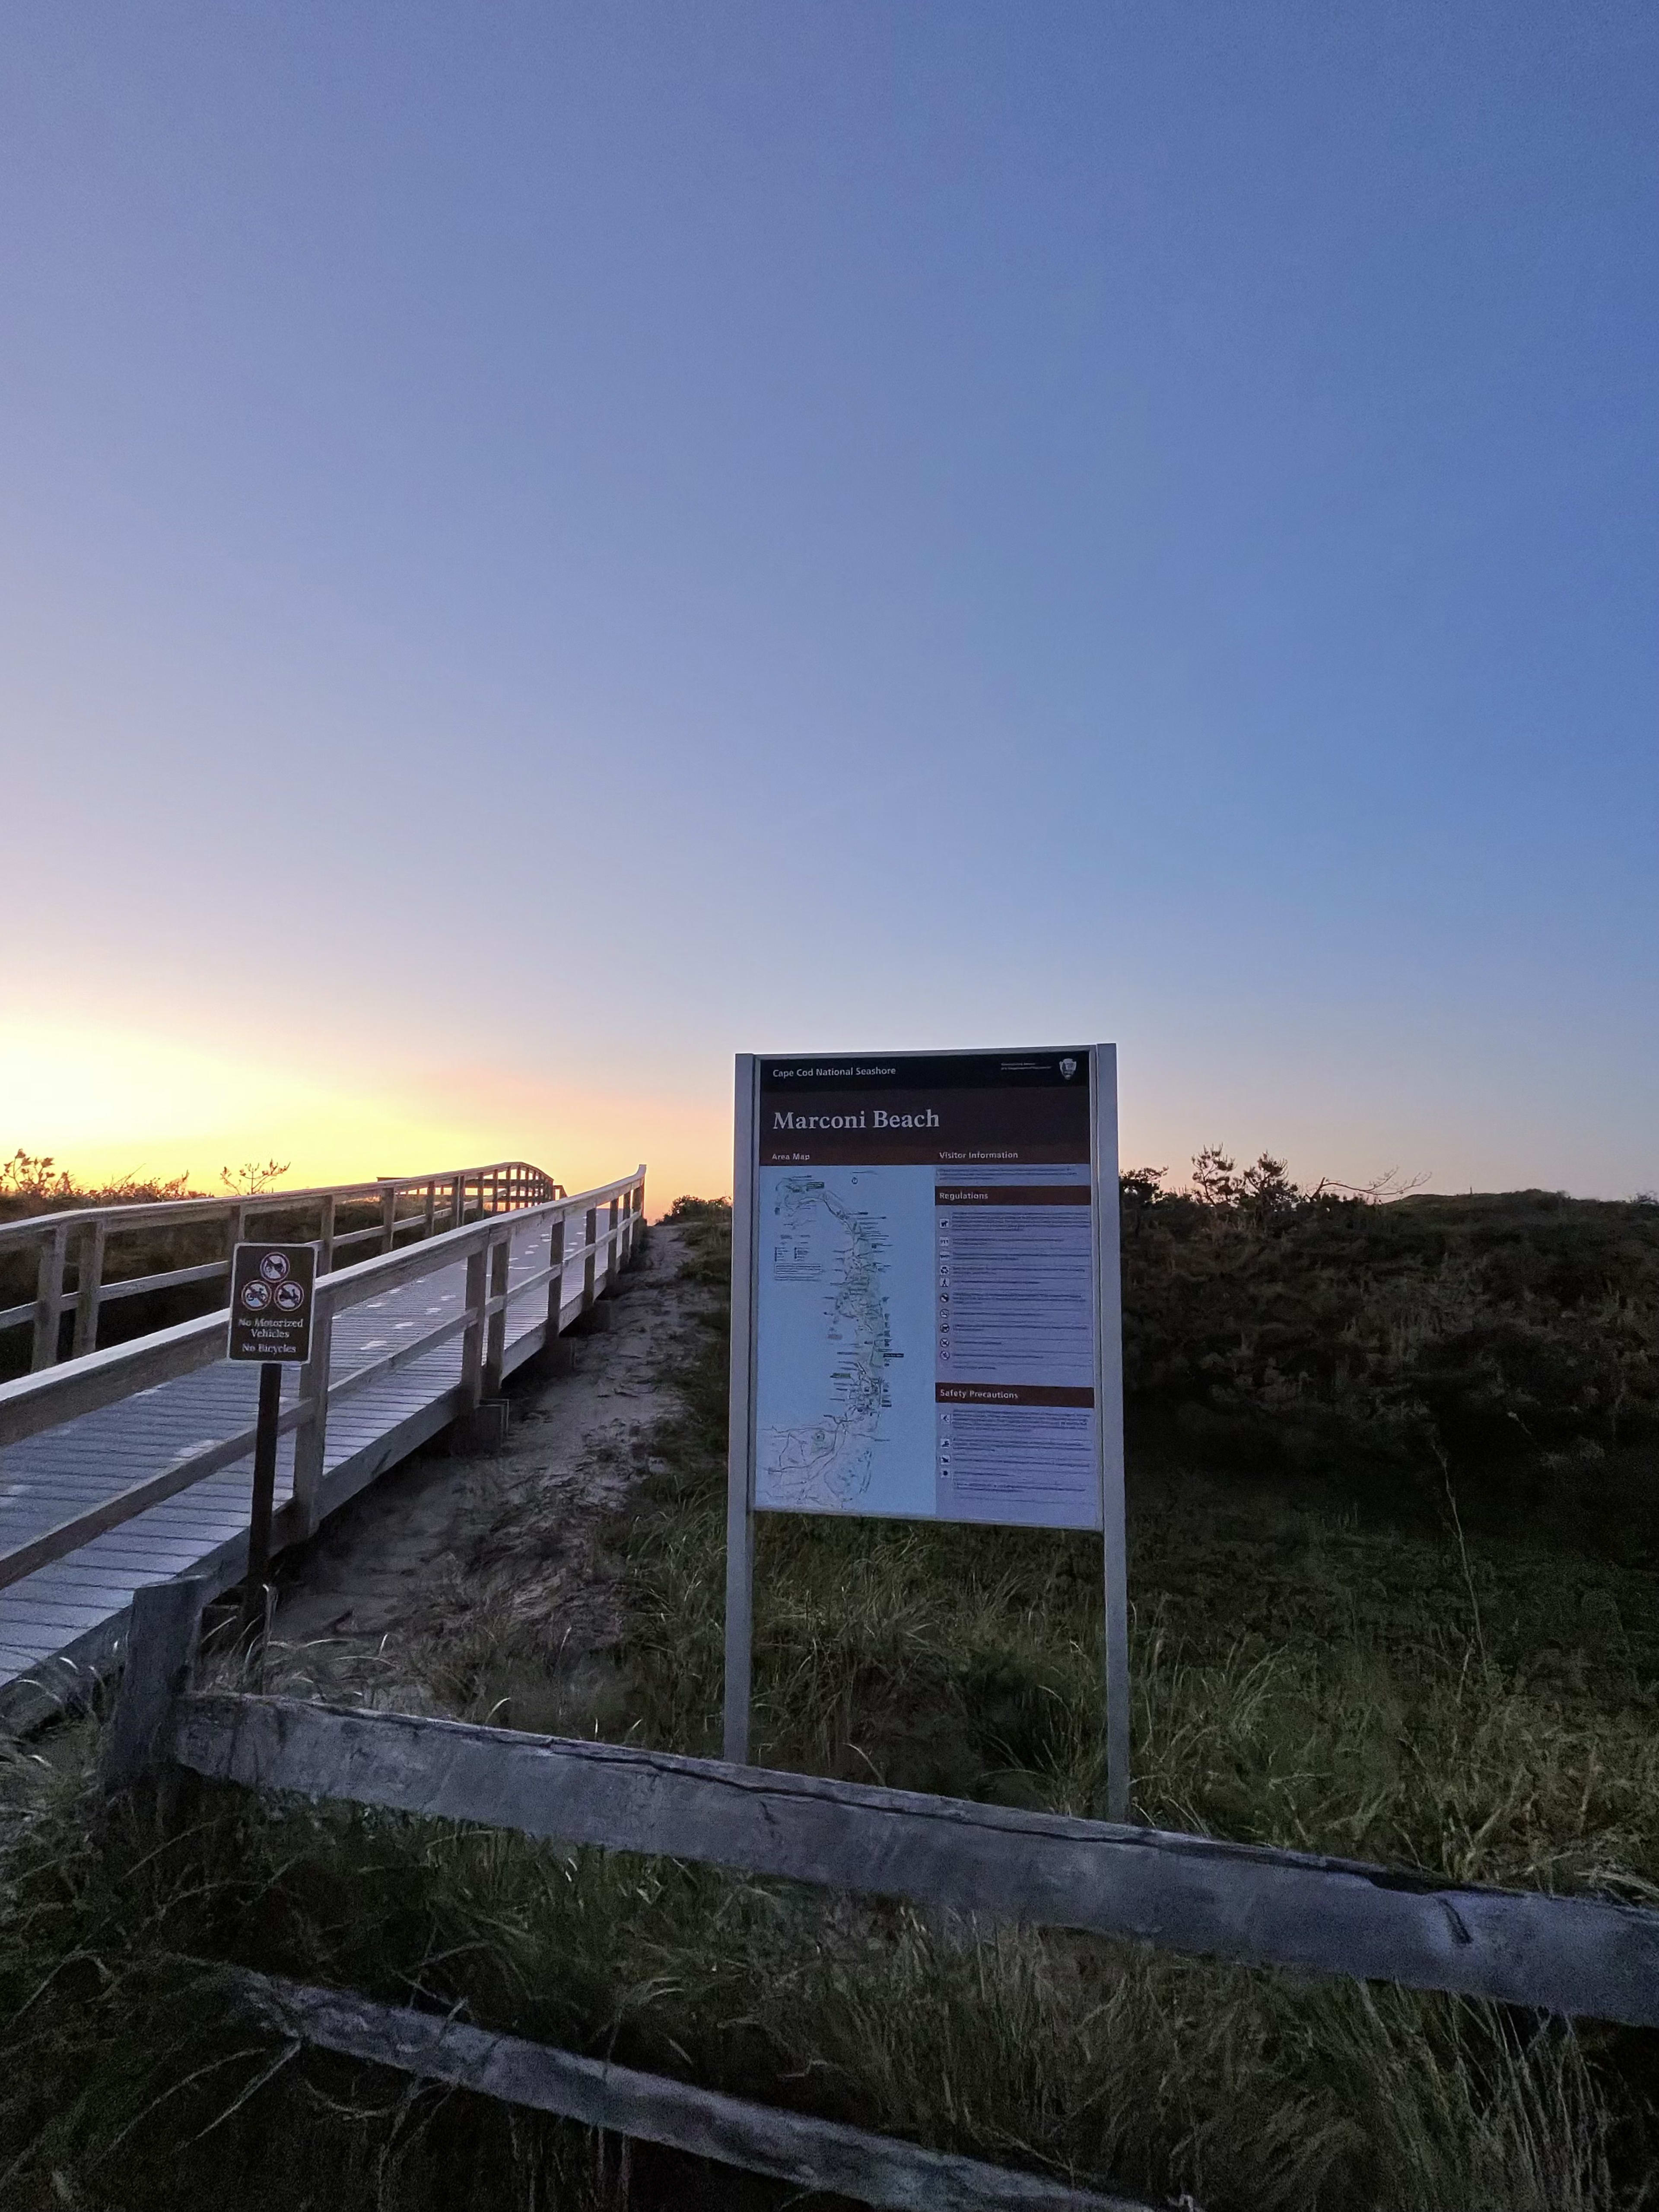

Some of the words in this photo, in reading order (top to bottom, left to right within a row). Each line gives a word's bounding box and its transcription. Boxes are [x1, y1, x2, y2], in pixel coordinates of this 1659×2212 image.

[772, 1069, 794, 1079] Cape
[796, 1068, 813, 1077] Cod
[816, 1067, 853, 1076] National
[856, 1067, 896, 1075] Seashore
[773, 1110, 866, 1129] Marconi
[873, 1109, 940, 1128] Beach
[939, 1191, 988, 1201] Regulations
[254, 1318, 304, 1327] Motorized
[251, 1328, 290, 1338] Vehicles
[242, 1343, 256, 1352] No
[258, 1344, 296, 1355] Bicycles
[940, 1389, 966, 1398] Safety
[969, 1390, 1018, 1399] Precautions
